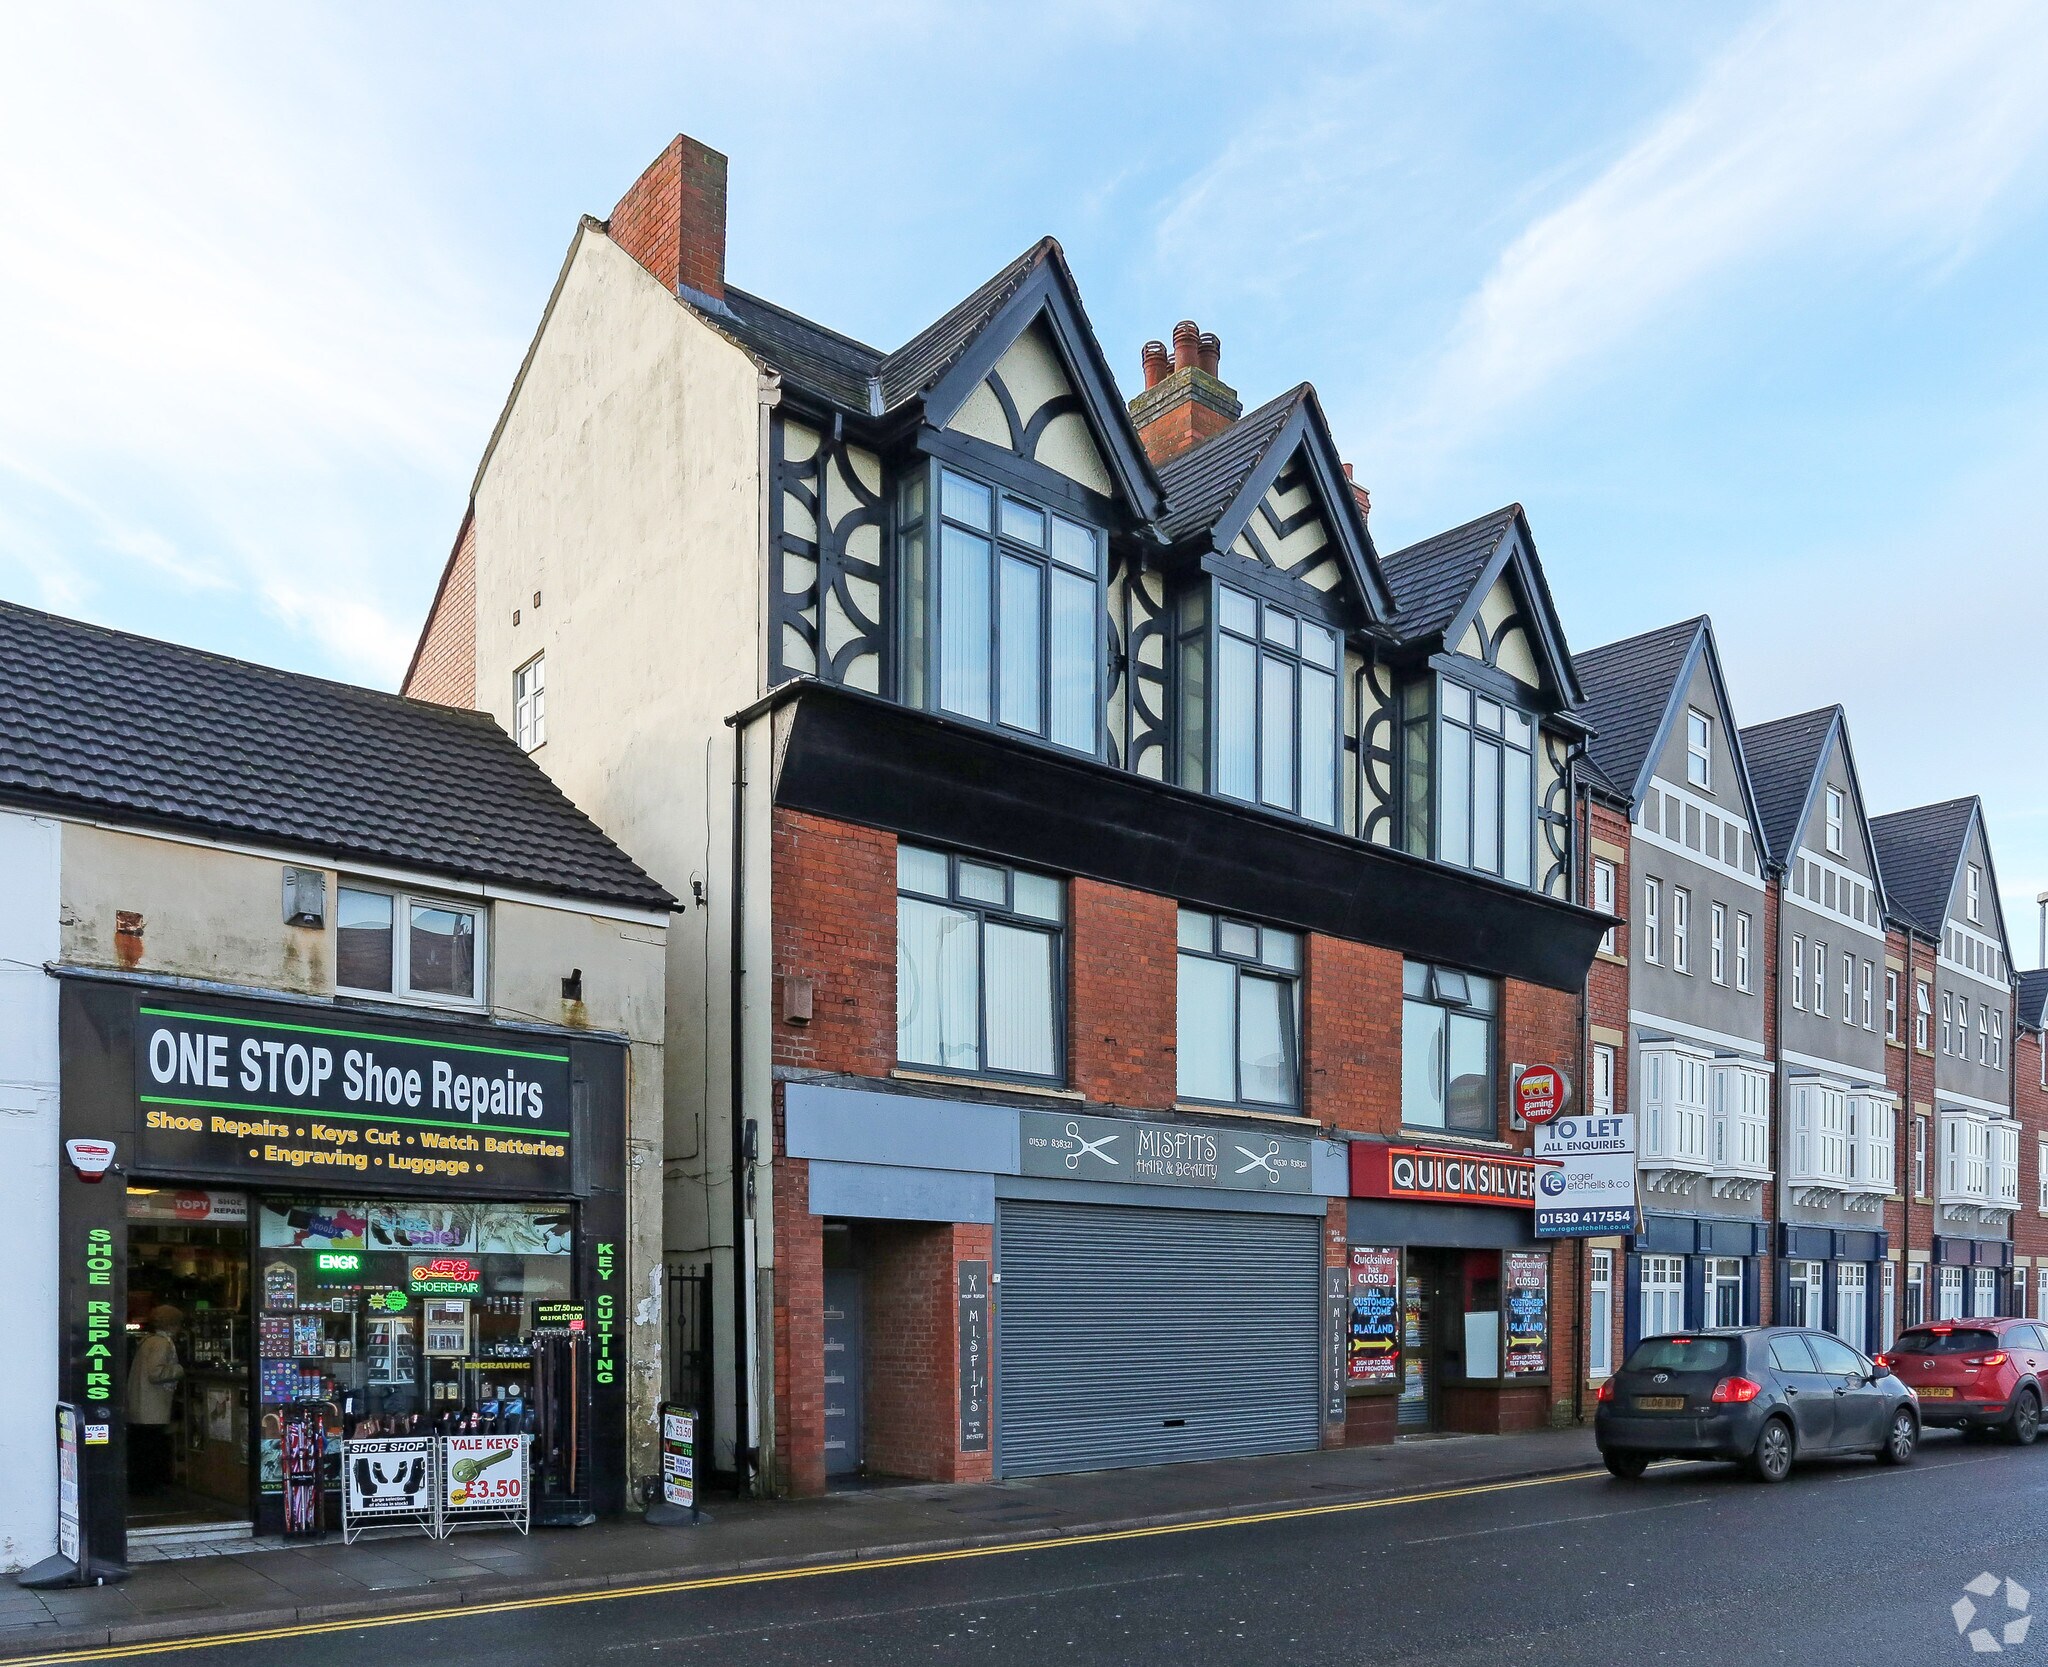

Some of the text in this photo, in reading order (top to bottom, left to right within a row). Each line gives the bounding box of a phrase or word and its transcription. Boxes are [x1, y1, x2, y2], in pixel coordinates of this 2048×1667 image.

[150, 1028, 544, 1124] ONE STOP Shoe Repairs
[1524, 1098, 1554, 1111] gaming
[1525, 1108, 1553, 1117] centre
[146, 1110, 565, 1157] Shoe Repairs Keys Cut Watch Batteries
[1546, 1118, 1623, 1139] TO LET
[1028, 1137, 1073, 1149] 01530 838321
[1137, 1129, 1218, 1162] MISFITS
[1543, 1139, 1626, 1152] ALL ENQUIRIES
[264, 1144, 470, 1176] Engraving Luggage
[1136, 1159, 1218, 1180] HAIR & BEAUTY
[1567, 1173, 1594, 1183] roger
[1567, 1179, 1630, 1190] etchells & co
[175, 1199, 209, 1211] TOPY
[217, 1198, 242, 1206] SHOE
[213, 1207, 246, 1215] REPAIR
[1539, 1210, 1631, 1224] 01530 417554
[309, 1219, 339, 1235] Scooby
[1539, 1223, 1631, 1233] www.rogeretchells.co.uk
[408, 1226, 461, 1245] sale!
[430, 1259, 469, 1271] KEYS
[1353, 1254, 1394, 1265] Quicksilver
[1511, 1259, 1543, 1270] Quicksilver
[1368, 1265, 1379, 1273] has
[453, 1271, 480, 1281] CUT
[1357, 1273, 1389, 1284] CLOSED
[1515, 1277, 1540, 1286] CLOSED
[1367, 1289, 1381, 1297] ALL
[1522, 1290, 1532, 1298] ALL
[1353, 1297, 1394, 1307] CUSTOMERS
[1510, 1298, 1544, 1307] CUSTOMERS
[85, 1229, 112, 1400] SHOE REPAIRS
[596, 1243, 614, 1384] KEY CUTTING
[1356, 1306, 1391, 1315] WELCOME
[1513, 1306, 1542, 1315] WELCOME
[1369, 1315, 1379, 1324] AT
[1523, 1314, 1530, 1323] AT
[1353, 1324, 1394, 1334] PLAYLAND
[1510, 1322, 1543, 1332] PLAYLAND
[968, 1310, 979, 1412] MISFITS
[675, 1426, 692, 1438] £3.50
[351, 1442, 425, 1453] SHOE SHOP
[451, 1437, 519, 1450] YALE KEYS
[675, 1457, 691, 1467] WATCH
[675, 1465, 692, 1476] STRAPS
[465, 1479, 521, 1499] £3.50
